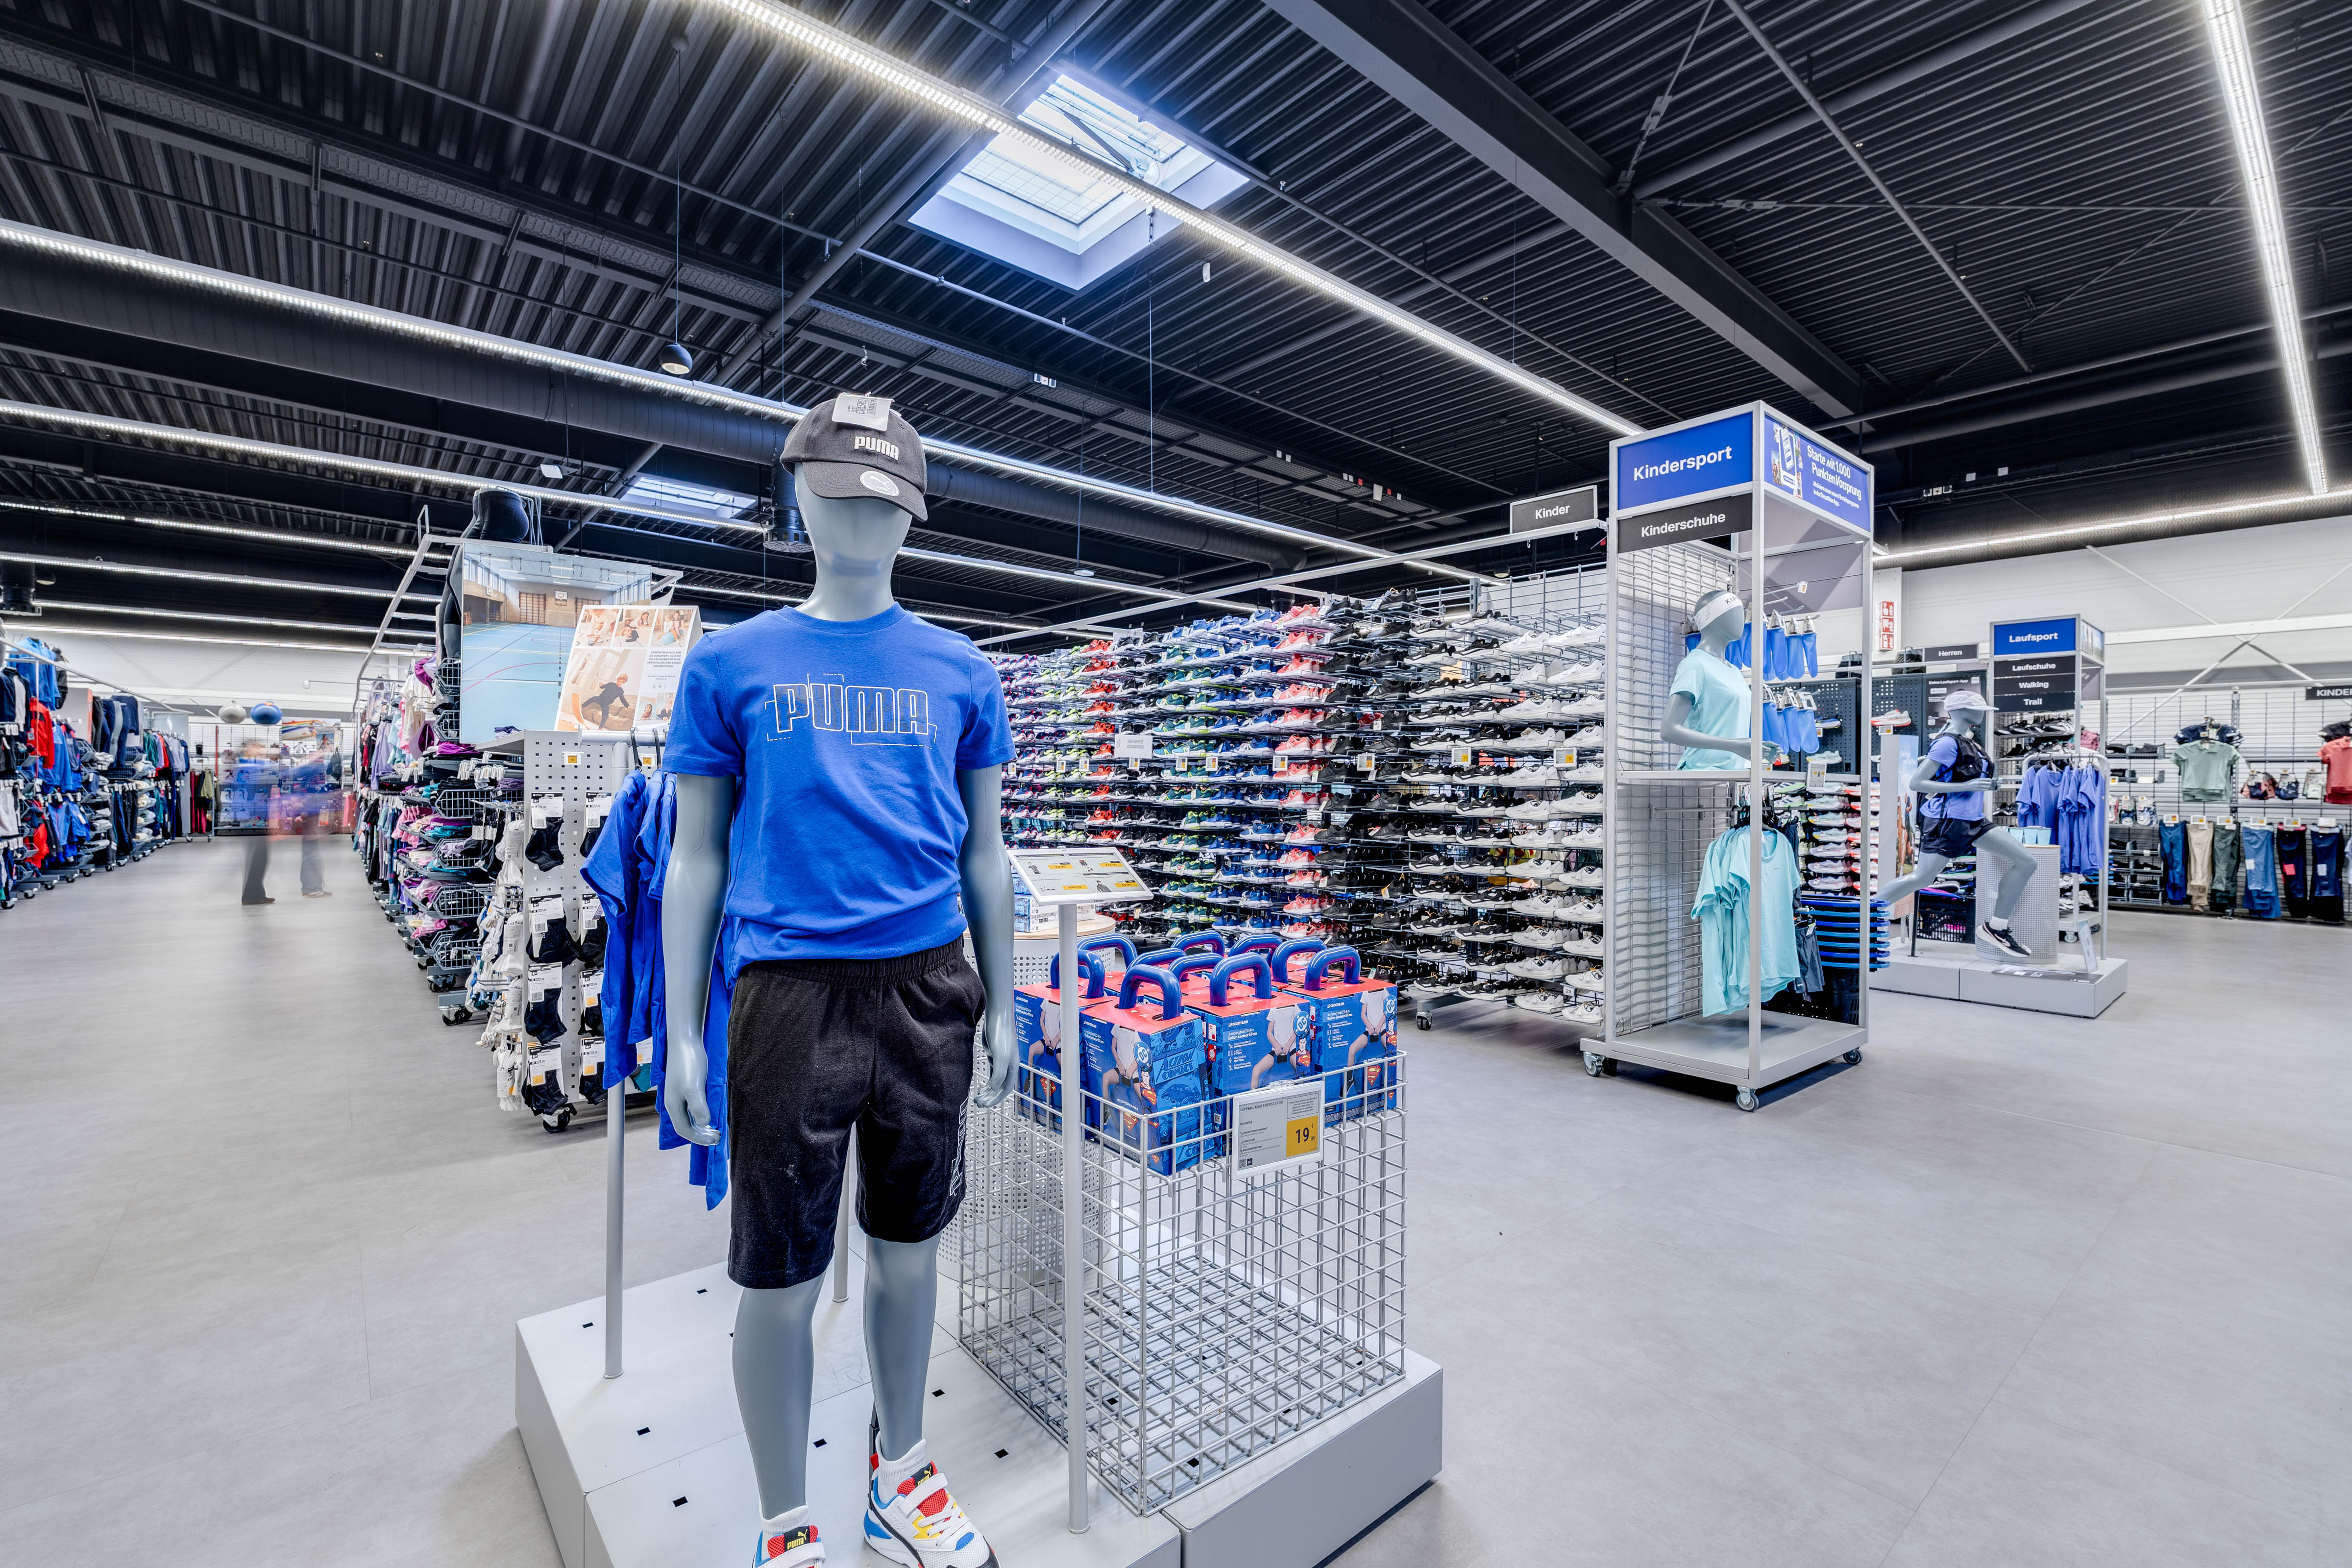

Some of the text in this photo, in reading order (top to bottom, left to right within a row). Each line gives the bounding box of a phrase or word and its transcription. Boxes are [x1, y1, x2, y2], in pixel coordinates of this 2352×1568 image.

[854, 436, 899, 461] PUMA
[1807, 445, 1826, 466] Starte
[1633, 445, 1733, 482] Kindersport
[1811, 462, 1862, 501] Punkten Vorsprung
[1535, 504, 1570, 520] Kinder
[1641, 513, 1726, 538] Kinderschuhe
[2009, 632, 2058, 643] Laufsport
[2012, 663, 2057, 672] Laufschuhe
[773, 683, 929, 735] PUMA
[1387, 1000, 1395, 1011] DC
[1298, 1017, 1307, 1029] DC
[1138, 1049, 1148, 1061] DC
[1156, 1048, 1195, 1082] ACTION
[1162, 1062, 1194, 1080] COMICS
[1117, 1099, 1139, 1111] SUPERMAN
[1296, 1127, 1309, 1143] 19
[787, 1537, 804, 1550] PUMA
